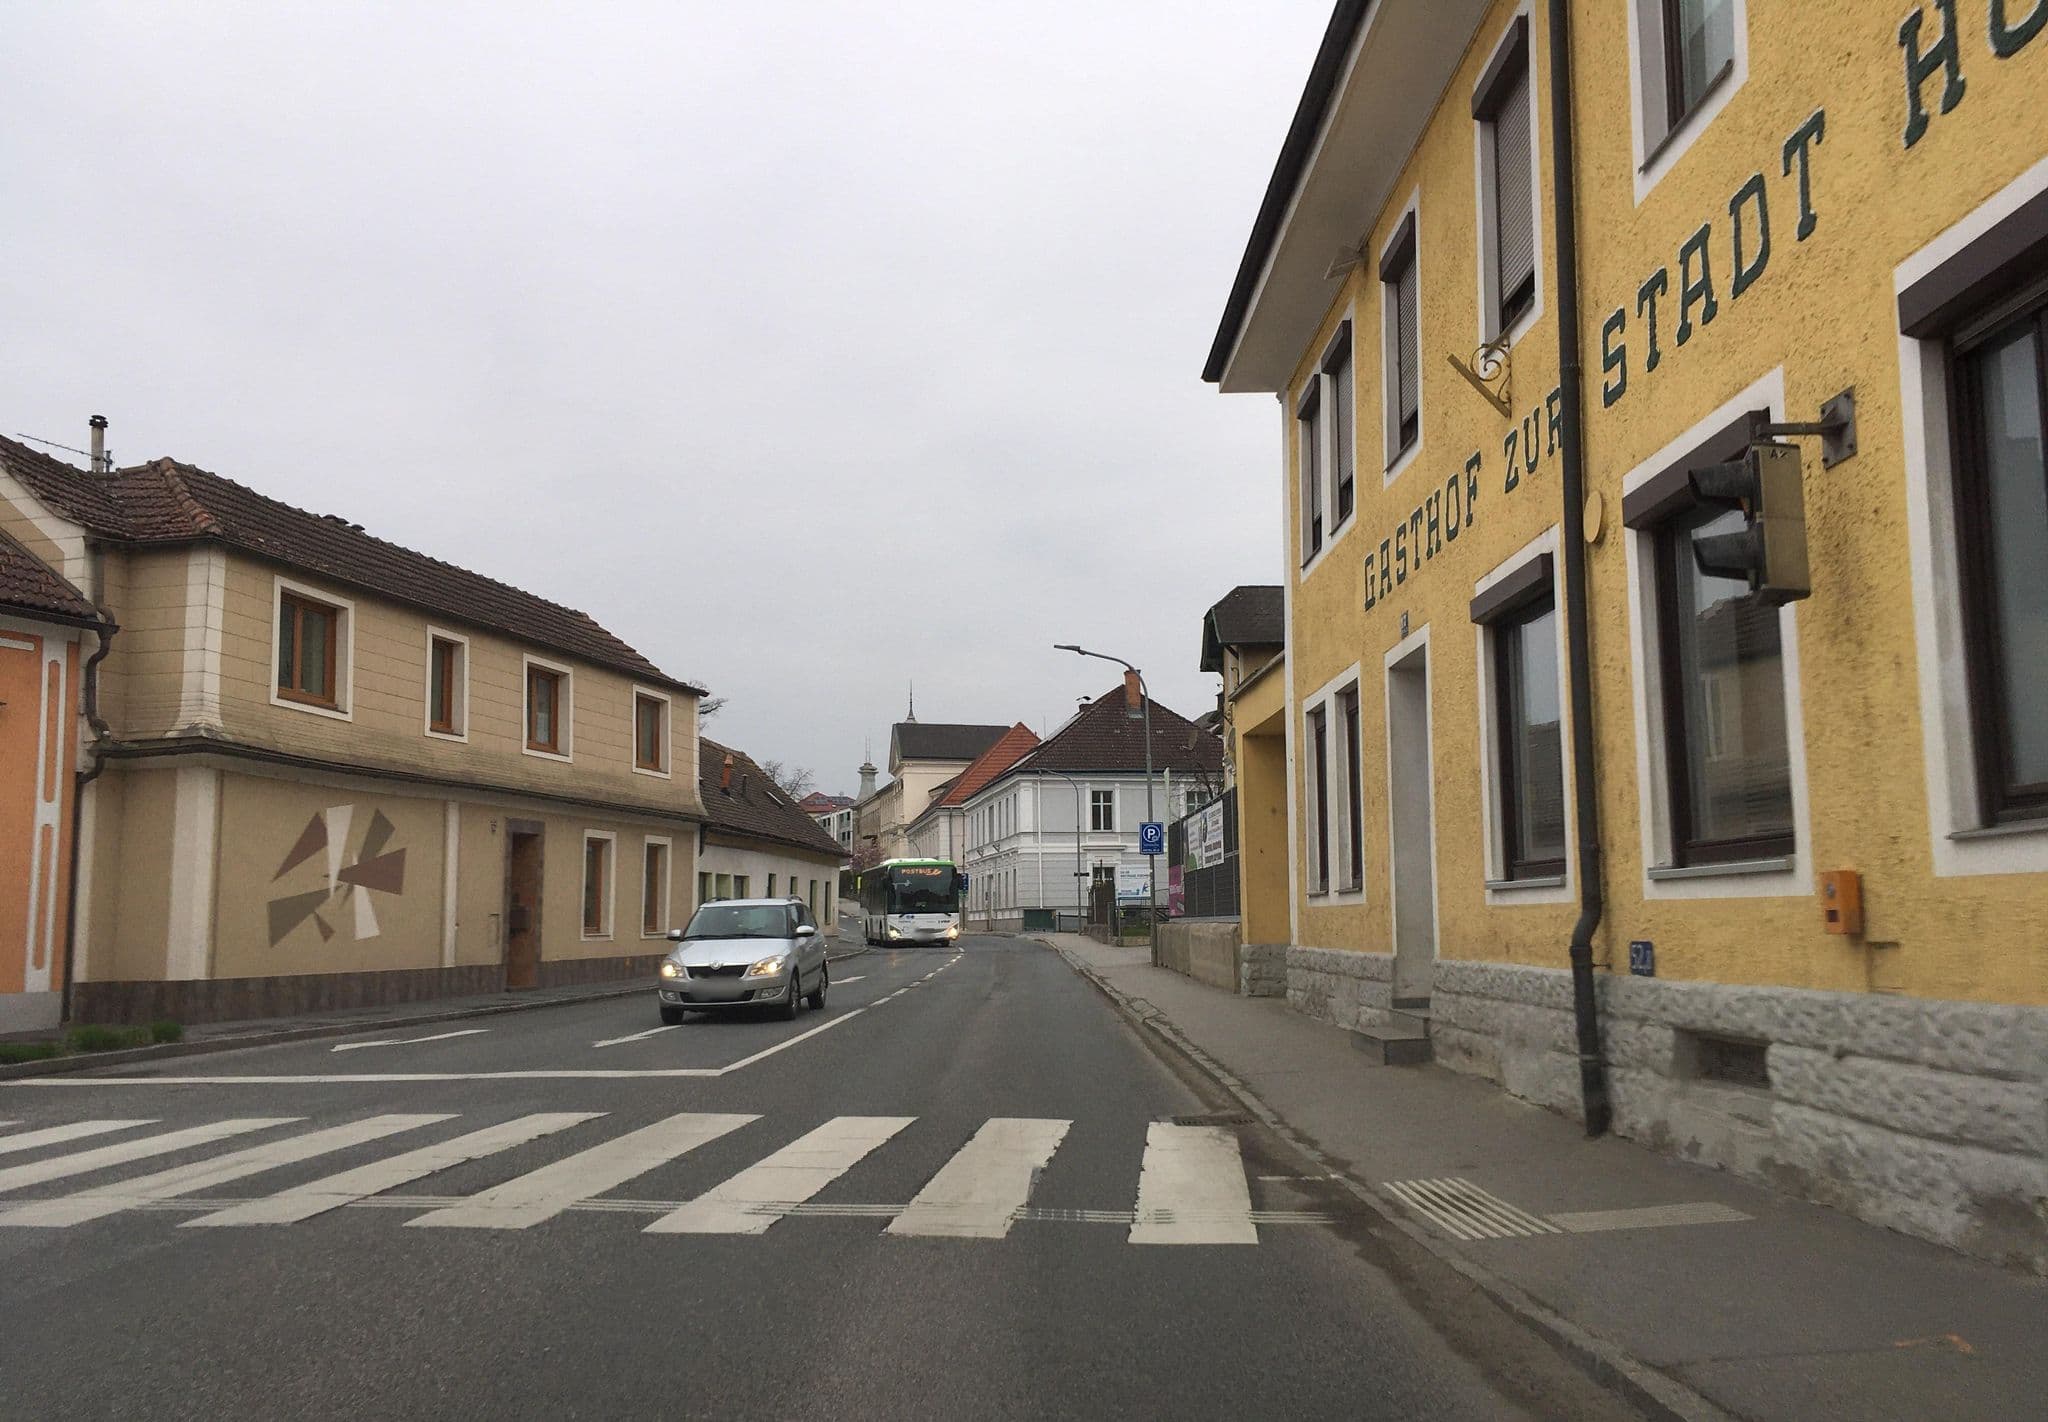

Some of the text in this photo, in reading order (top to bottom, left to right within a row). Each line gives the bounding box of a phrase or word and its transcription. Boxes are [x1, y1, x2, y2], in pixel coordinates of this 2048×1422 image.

[1364, 450, 1481, 612] GASTHOF
[1504, 386, 1562, 494] ZUR
[1601, 106, 1826, 408] STADT
[1148, 828, 1156, 839] P
